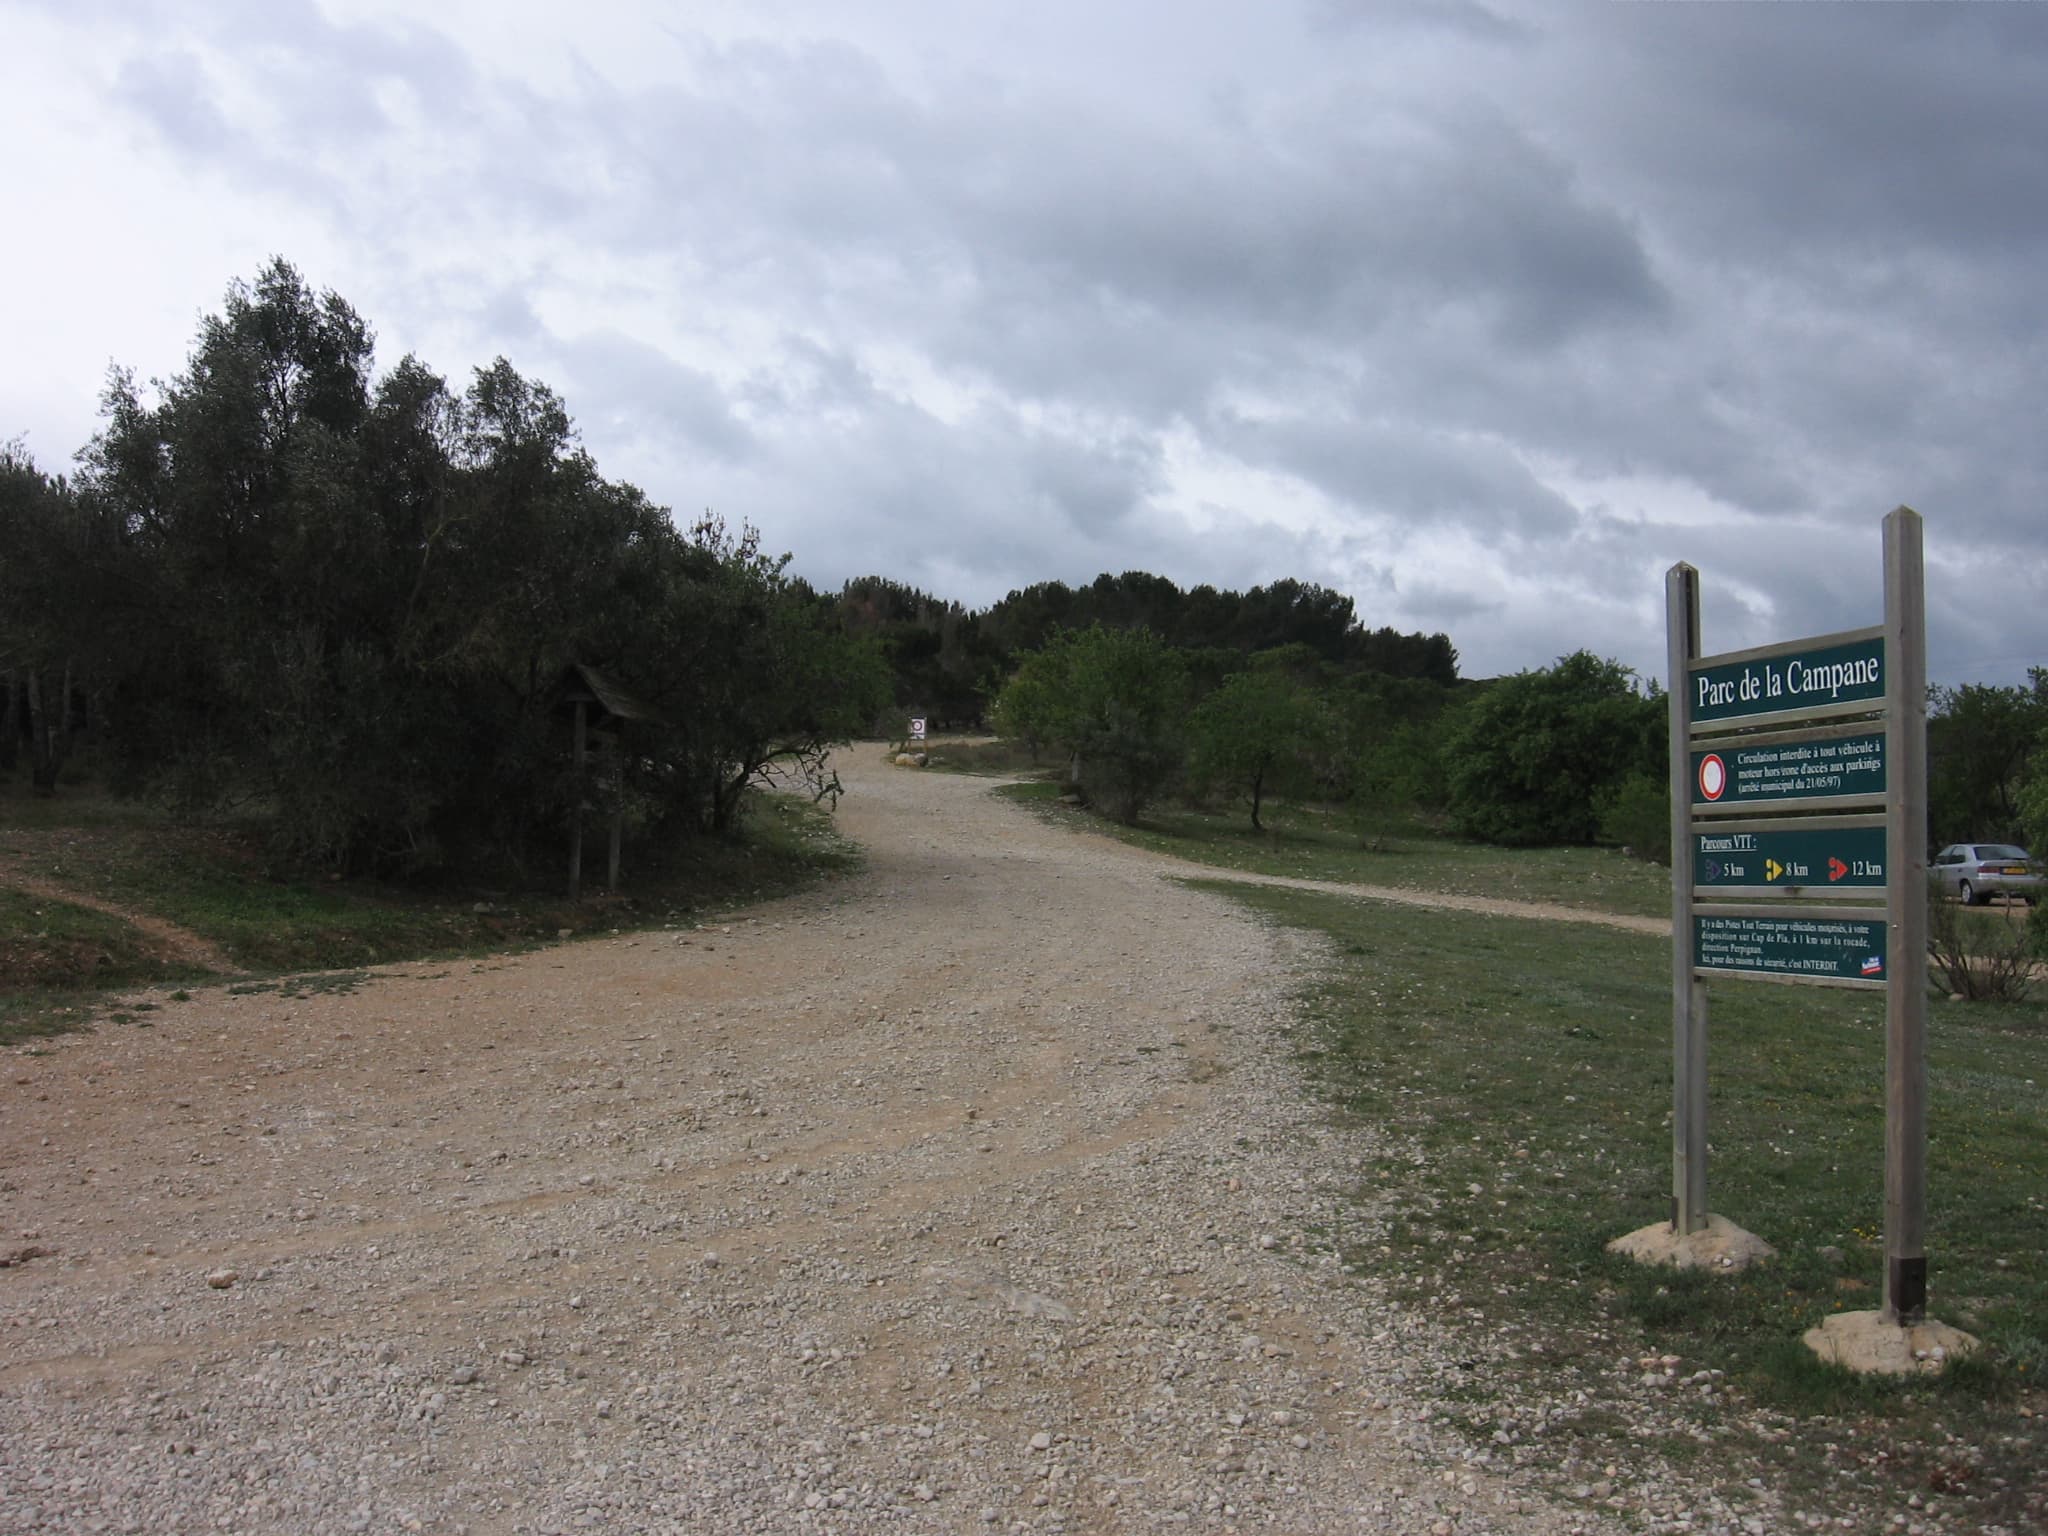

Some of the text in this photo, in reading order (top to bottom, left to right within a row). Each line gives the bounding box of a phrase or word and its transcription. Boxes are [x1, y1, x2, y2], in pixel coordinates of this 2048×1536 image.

[1697, 657, 1878, 707] Parc de la Campane
[1737, 740, 1880, 764] Circulation interdite à tout véhicule à
[1738, 769, 1763, 779] moteur
[1764, 766, 1780, 777] hors
[1800, 762, 1829, 775] d'accès
[1829, 762, 1844, 773] aux
[1846, 757, 1881, 774] parkings
[1738, 775, 1841, 794] (arrêté municipal du 21/05/97)
[1700, 836, 1732, 850] Parcours
[1733, 835, 1751, 849] VTT
[1723, 863, 1745, 877] 5 km
[1785, 862, 1808, 876] 8 km
[1852, 861, 1882, 876] 12 km
[1701, 930, 1737, 942] disposition
[1739, 934, 1750, 942] sur
[1766, 933, 1775, 943] de
[1792, 933, 1797, 944] à
[1805, 934, 1818, 944] km
[1820, 937, 1832, 945] sur
[1833, 935, 1842, 946] la
[1843, 937, 1871, 948] rocade,
[1702, 941, 1764, 956] direction Perpignan.
[1755, 957, 1762, 966] de
[1802, 960, 1840, 972] INTERDIT.
